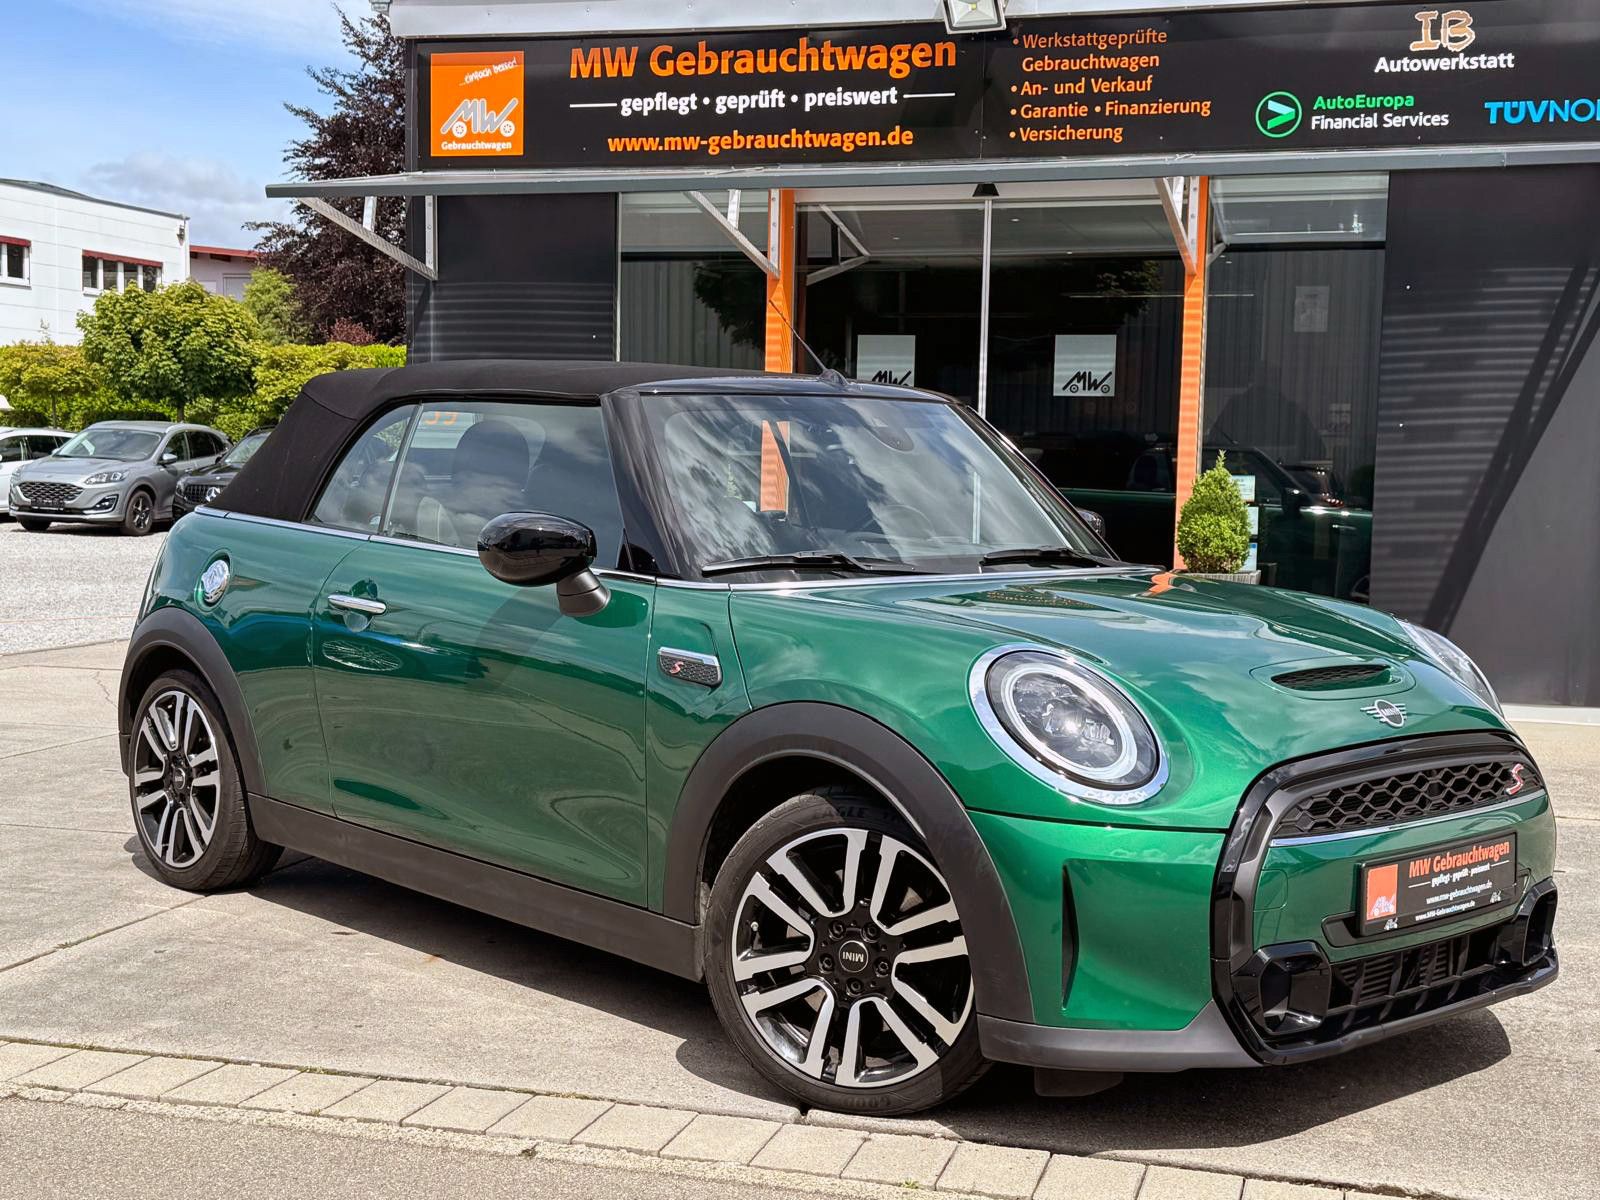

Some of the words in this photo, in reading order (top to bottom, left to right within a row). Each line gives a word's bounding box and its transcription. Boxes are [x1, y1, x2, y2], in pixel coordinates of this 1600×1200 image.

[1022, 28, 1168, 49] Werkstattgeprüfte
[1409, 10, 1475, 52] IB
[570, 46, 639, 79] MW
[649, 37, 957, 79] Gebrauchtwagen
[1022, 53, 1160, 72] Gebrauchtwagen
[1374, 52, 1515, 73] Autowerkstatt
[1020, 81, 1049, 96] An-
[1054, 77, 1085, 95] und
[1091, 75, 1153, 93] Verkauf
[621, 92, 698, 116] gepflegt
[715, 88, 786, 114] geprüft
[804, 86, 898, 112] preiswert
[1020, 102, 1089, 119] Garantie
[1105, 98, 1212, 117] Finanzierung
[1313, 94, 1415, 110] AutoEuropa
[1484, 98, 1600, 124] TÜVNO
[440, 97, 519, 135] MW
[1311, 113, 1378, 130] Financial
[1382, 112, 1450, 129] Services
[607, 125, 914, 155] www.mw-gebrauchtwagen.de
[1019, 125, 1124, 143] Versicherung
[441, 140, 512, 152] Gebrauchtwagen
[669, 661, 684, 675] S
[1506, 763, 1525, 795] S
[1409, 858, 1431, 878] MW
[1433, 841, 1510, 873] Gebrauchtwagen
[842, 951, 864, 963] MINI
